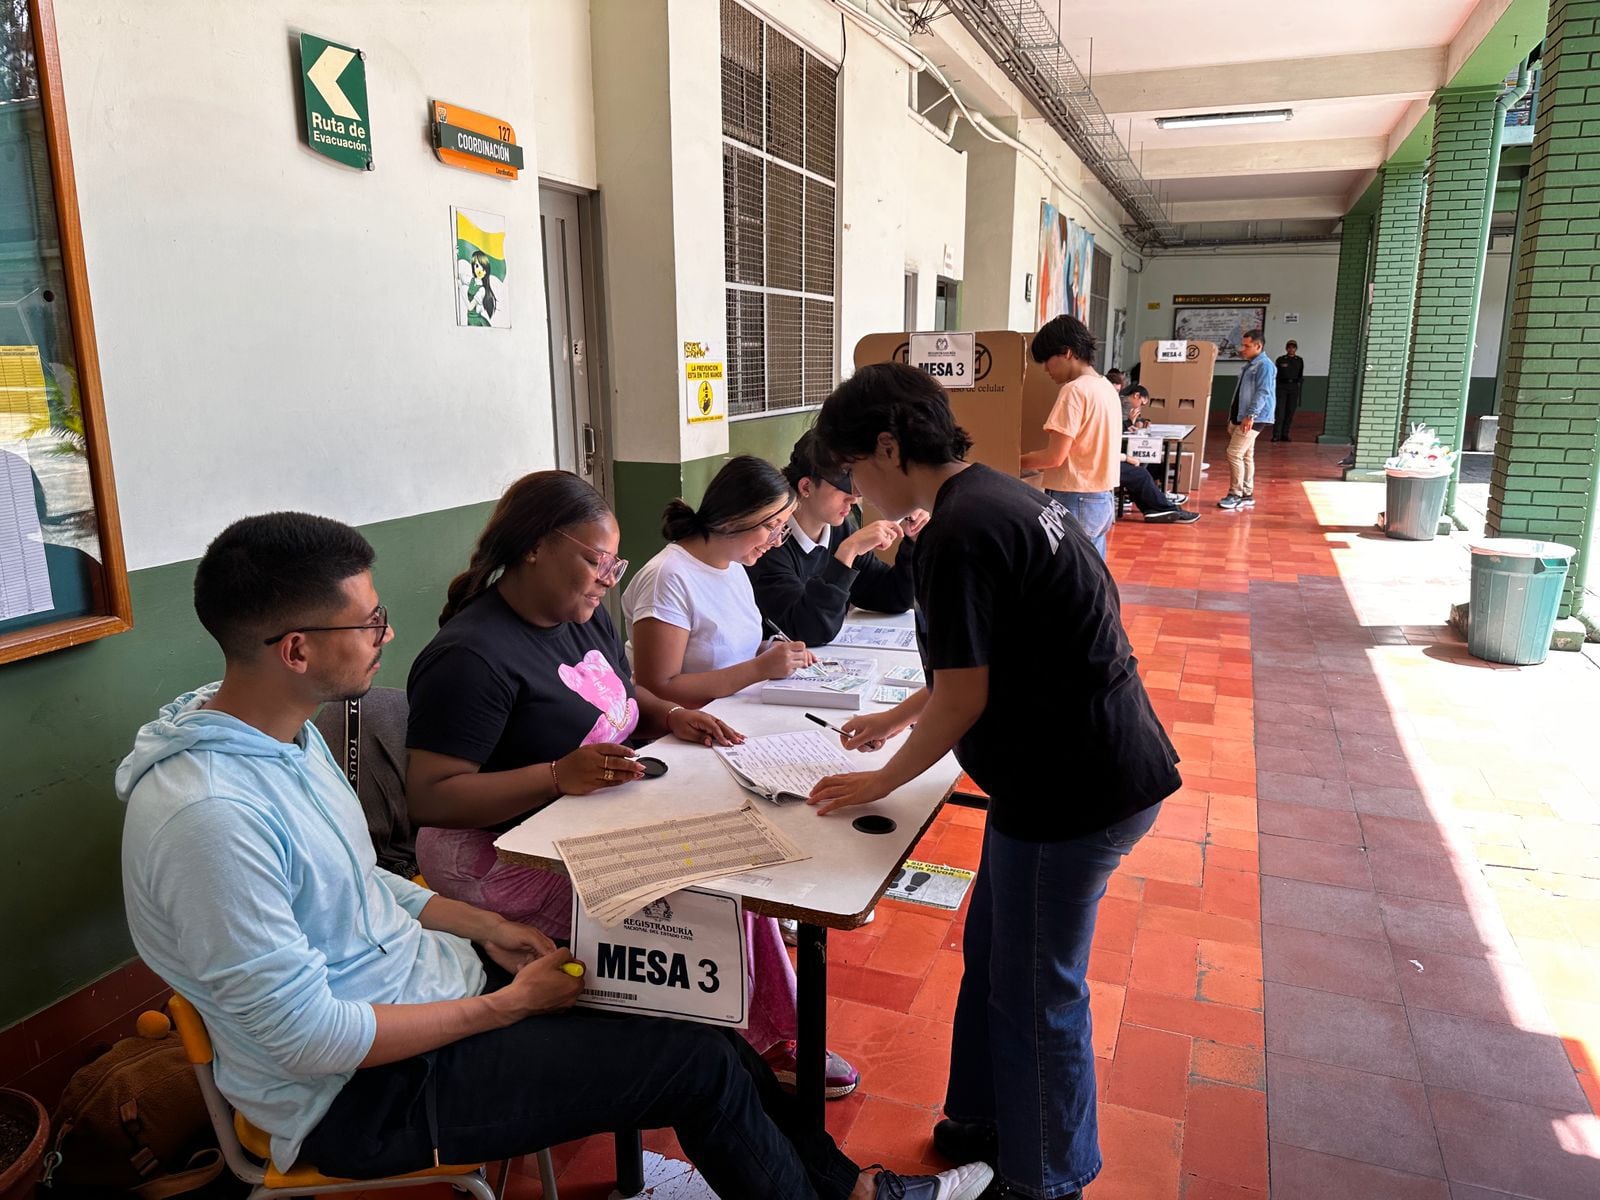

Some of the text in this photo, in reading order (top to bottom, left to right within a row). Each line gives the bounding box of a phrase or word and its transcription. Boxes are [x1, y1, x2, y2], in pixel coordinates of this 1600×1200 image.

[311, 111, 366, 138] Ruta de
[498, 125, 511, 142] 127
[313, 130, 367, 152] Evacuación
[457, 132, 510, 162] COORDINACIÓN
[918, 362, 965, 377] MESA 3
[977, 383, 1005, 392] celular
[1132, 450, 1151, 458] MESA
[349, 738, 358, 781] TOUS
[926, 867, 954, 876] FAVOR
[623, 918, 694, 937] REGISTRADURÍA
[623, 925, 648, 933] NACIONAL
[660, 930, 680, 939] ESTADO
[596, 942, 721, 993] MESA 3
